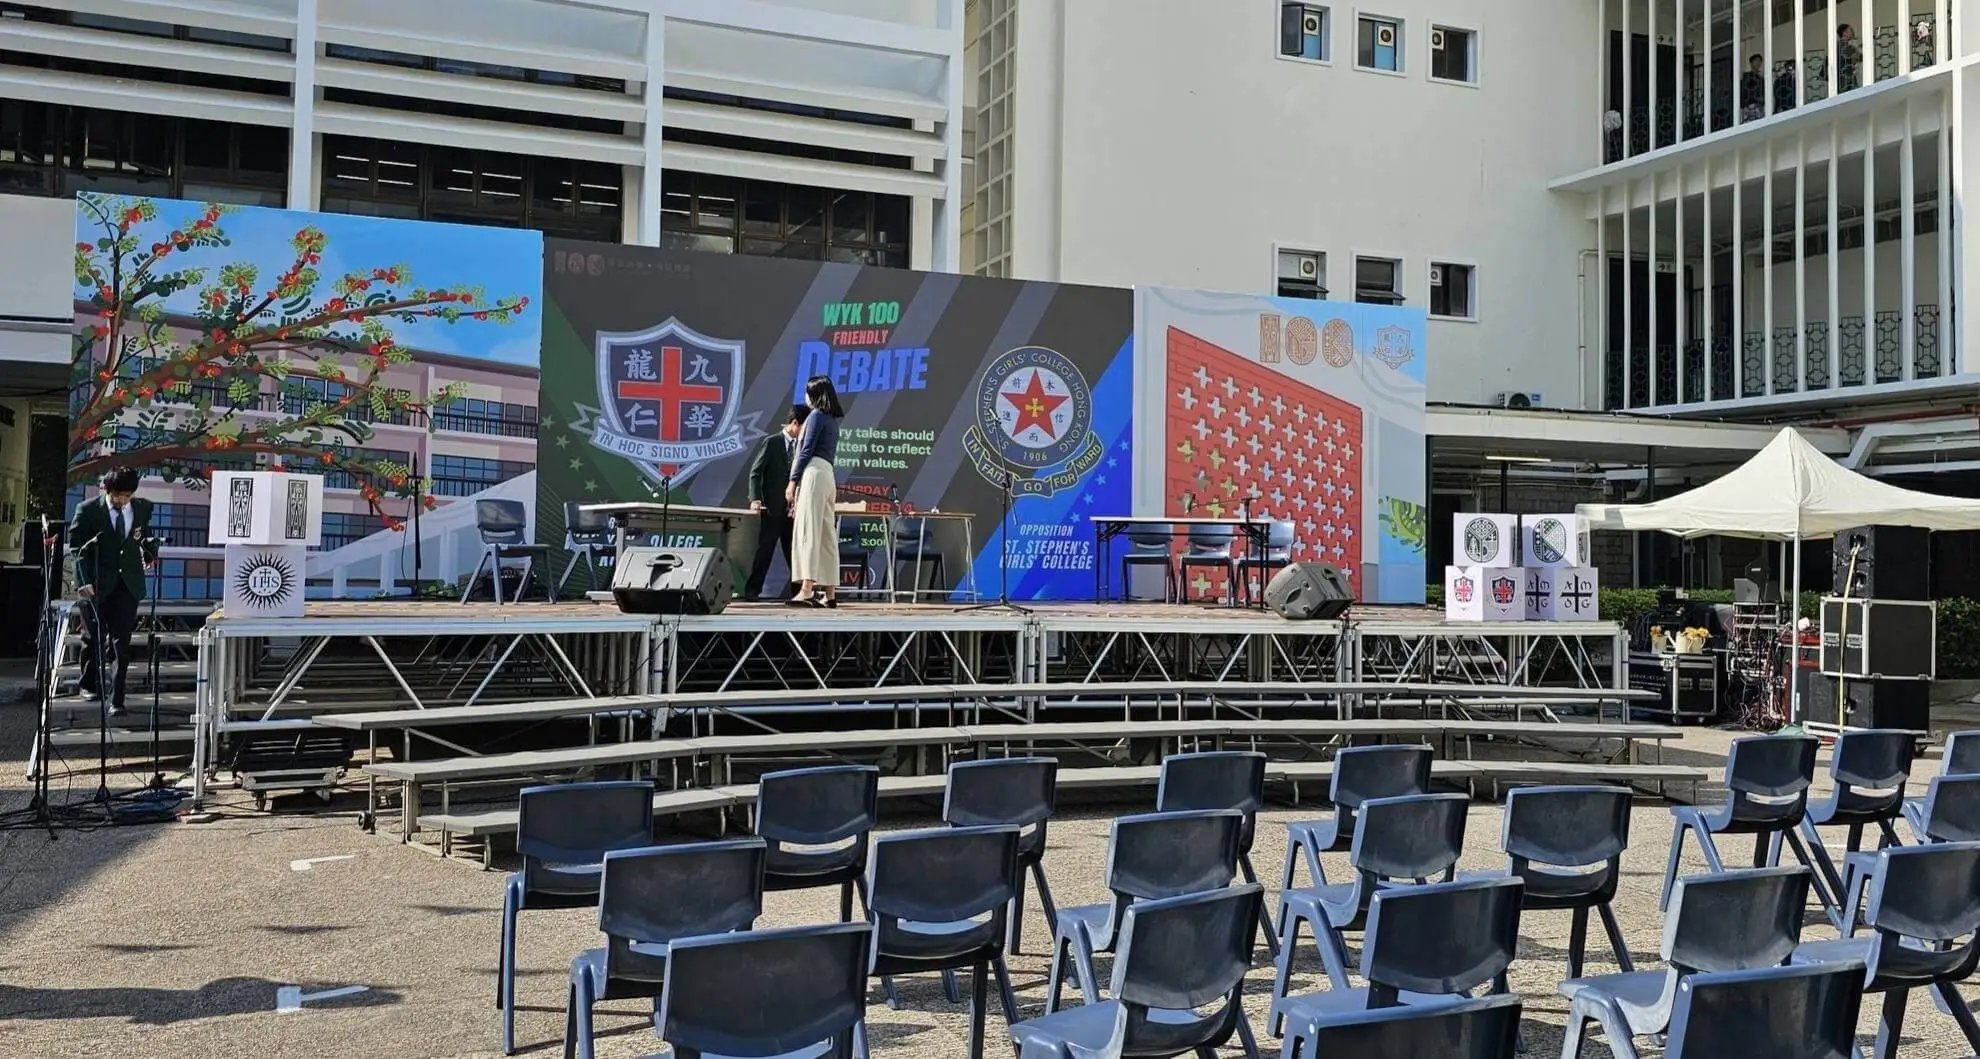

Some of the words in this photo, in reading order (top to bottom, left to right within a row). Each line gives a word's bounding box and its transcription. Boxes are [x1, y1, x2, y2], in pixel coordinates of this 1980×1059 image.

[823, 303, 863, 327] WYK
[868, 302, 900, 324] 100
[832, 329, 889, 346] FRIENDLY
[623, 349, 658, 381] 龍
[684, 353, 718, 384] 九
[792, 341, 931, 406] DEBATE
[995, 353, 1026, 376] GIRLS'
[1031, 352, 1075, 381] COLLEGE
[1072, 382, 1086, 418] HONG
[624, 402, 658, 433] 仁
[684, 404, 715, 437] 華
[855, 427, 888, 439] tales
[891, 428, 935, 442] should
[1059, 422, 1084, 453] KONG
[600, 431, 613, 446] IN
[618, 438, 645, 455] HOC
[650, 444, 690, 459] SIGNO
[695, 438, 739, 457] VINCES
[836, 441, 868, 453] itten
[870, 442, 885, 454] to
[888, 443, 932, 455] reflect
[863, 457, 909, 469] values.
[967, 440, 980, 453] IN
[1023, 482, 1043, 492] GO
[1053, 473, 1076, 487] FOR
[1075, 444, 1101, 469] WARD
[1023, 451, 1048, 462] 1906
[1019, 524, 1074, 537] OPPOSITION
[1005, 540, 1022, 555] ST.
[1025, 540, 1090, 555] STEPHEN'S
[1042, 555, 1094, 570] COLLEGE
[252, 575, 281, 588] IHS
[1581, 598, 1590, 609] G
